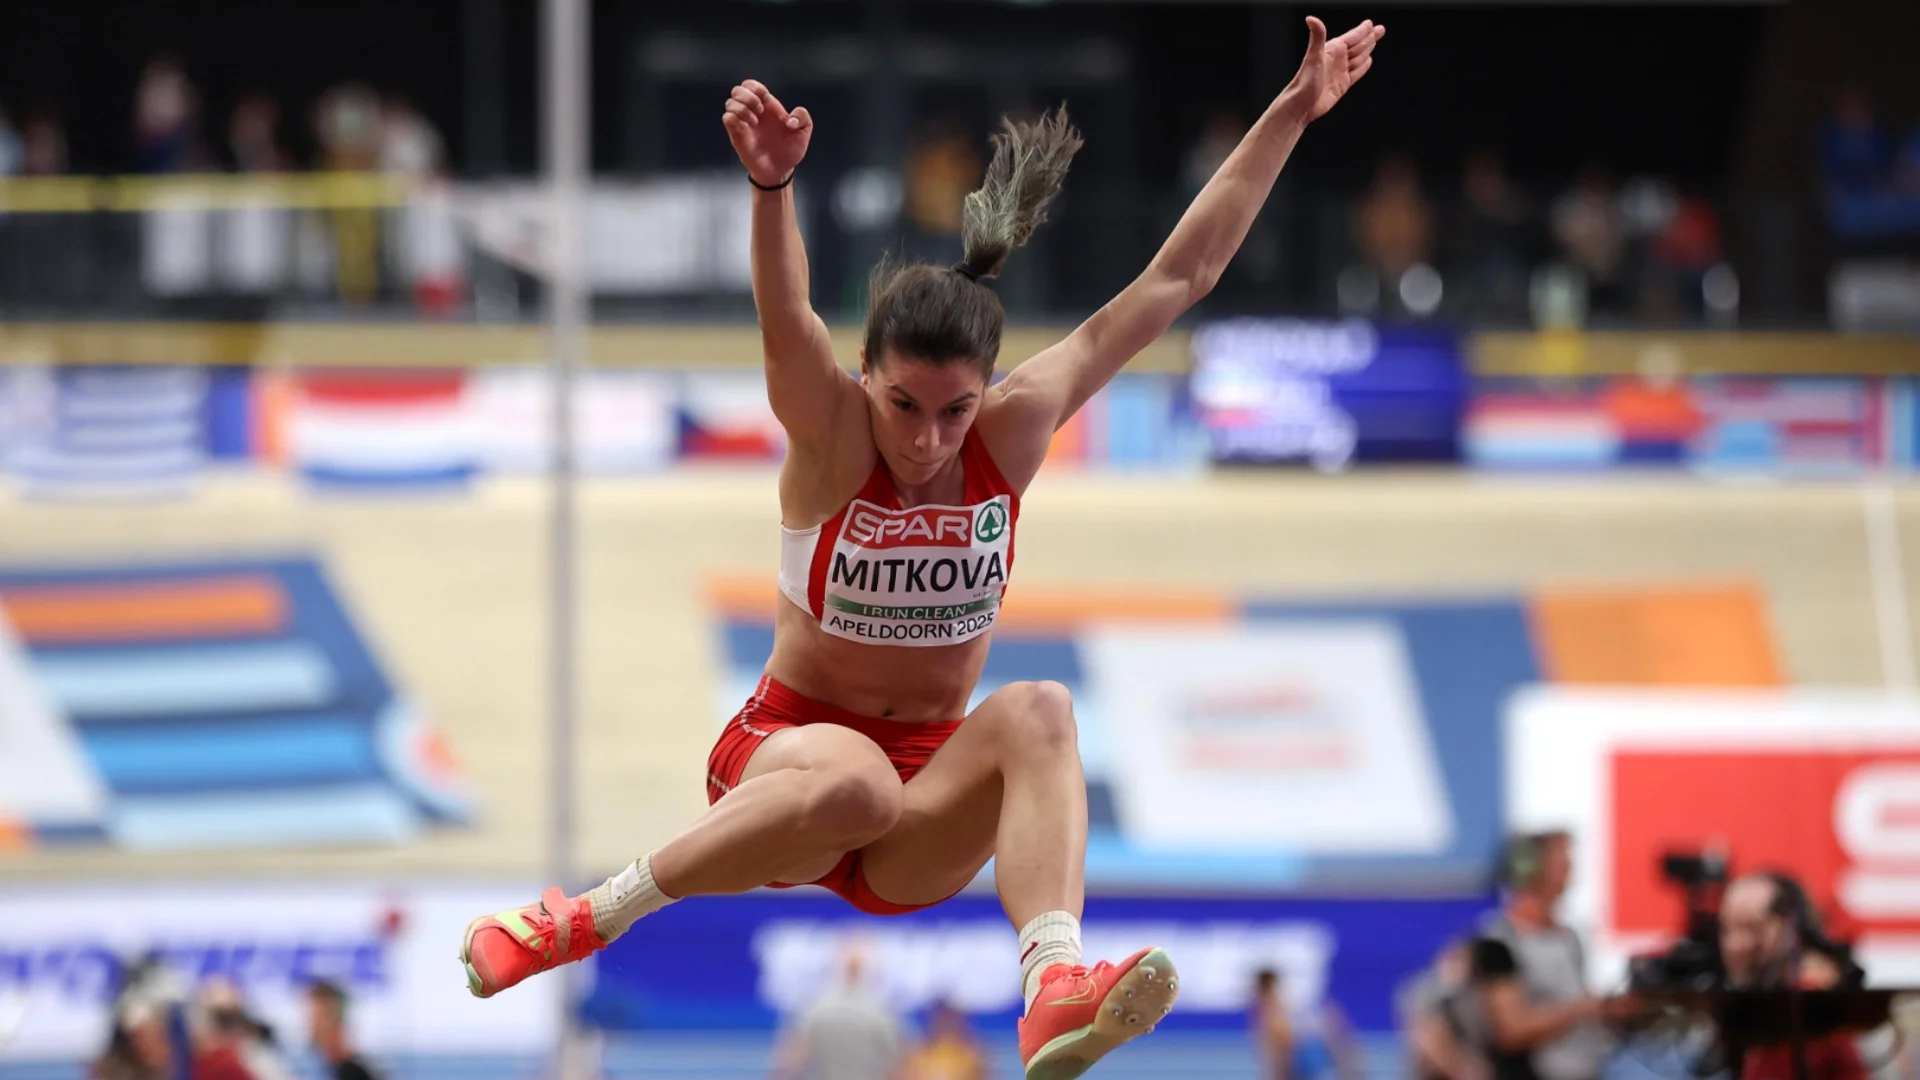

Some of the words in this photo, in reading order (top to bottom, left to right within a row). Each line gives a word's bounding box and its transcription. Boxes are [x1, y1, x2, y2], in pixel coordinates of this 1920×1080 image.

[850, 511, 969, 544] SPAR
[831, 551, 1004, 593] MITKOVA
[829, 615, 953, 640] APELDOORN
[956, 612, 994, 636] 2025
[863, 605, 867, 615] I
[871, 606, 908, 620] RUN
[912, 605, 967, 620] CLEAN
